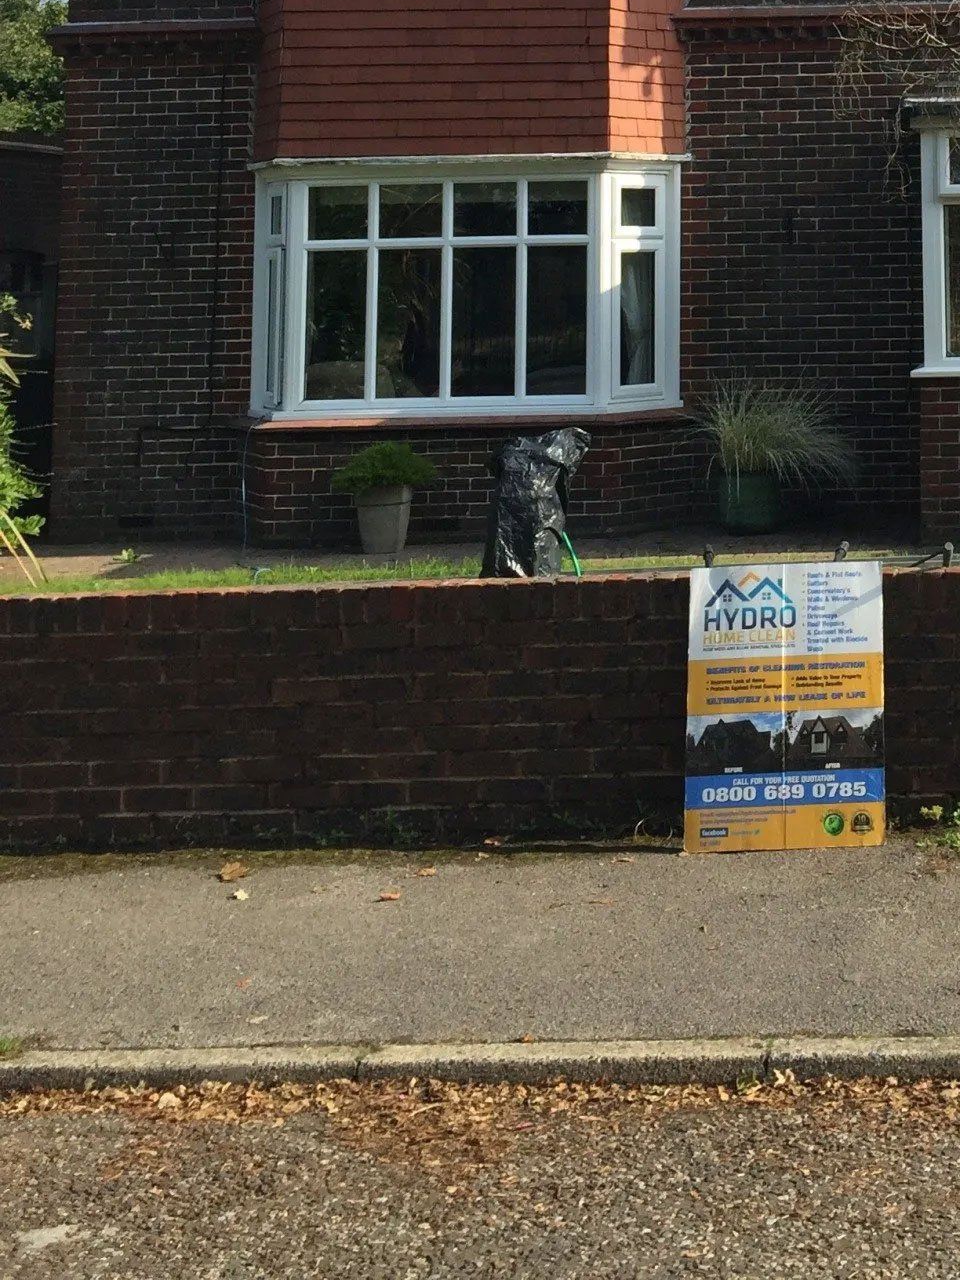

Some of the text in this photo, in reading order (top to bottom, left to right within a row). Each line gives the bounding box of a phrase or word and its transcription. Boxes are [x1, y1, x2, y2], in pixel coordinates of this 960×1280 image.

[704, 605, 796, 631] HYDRO
[703, 629, 795, 645] HOME CLEAN
[808, 661, 865, 669] RESTORATION
[847, 691, 866, 699] LIFE
[733, 774, 835, 786] CALL FOR YOUR FREE QUOTATION
[702, 782, 866, 803] 0800 689 0785
[702, 828, 726, 837] facebook
